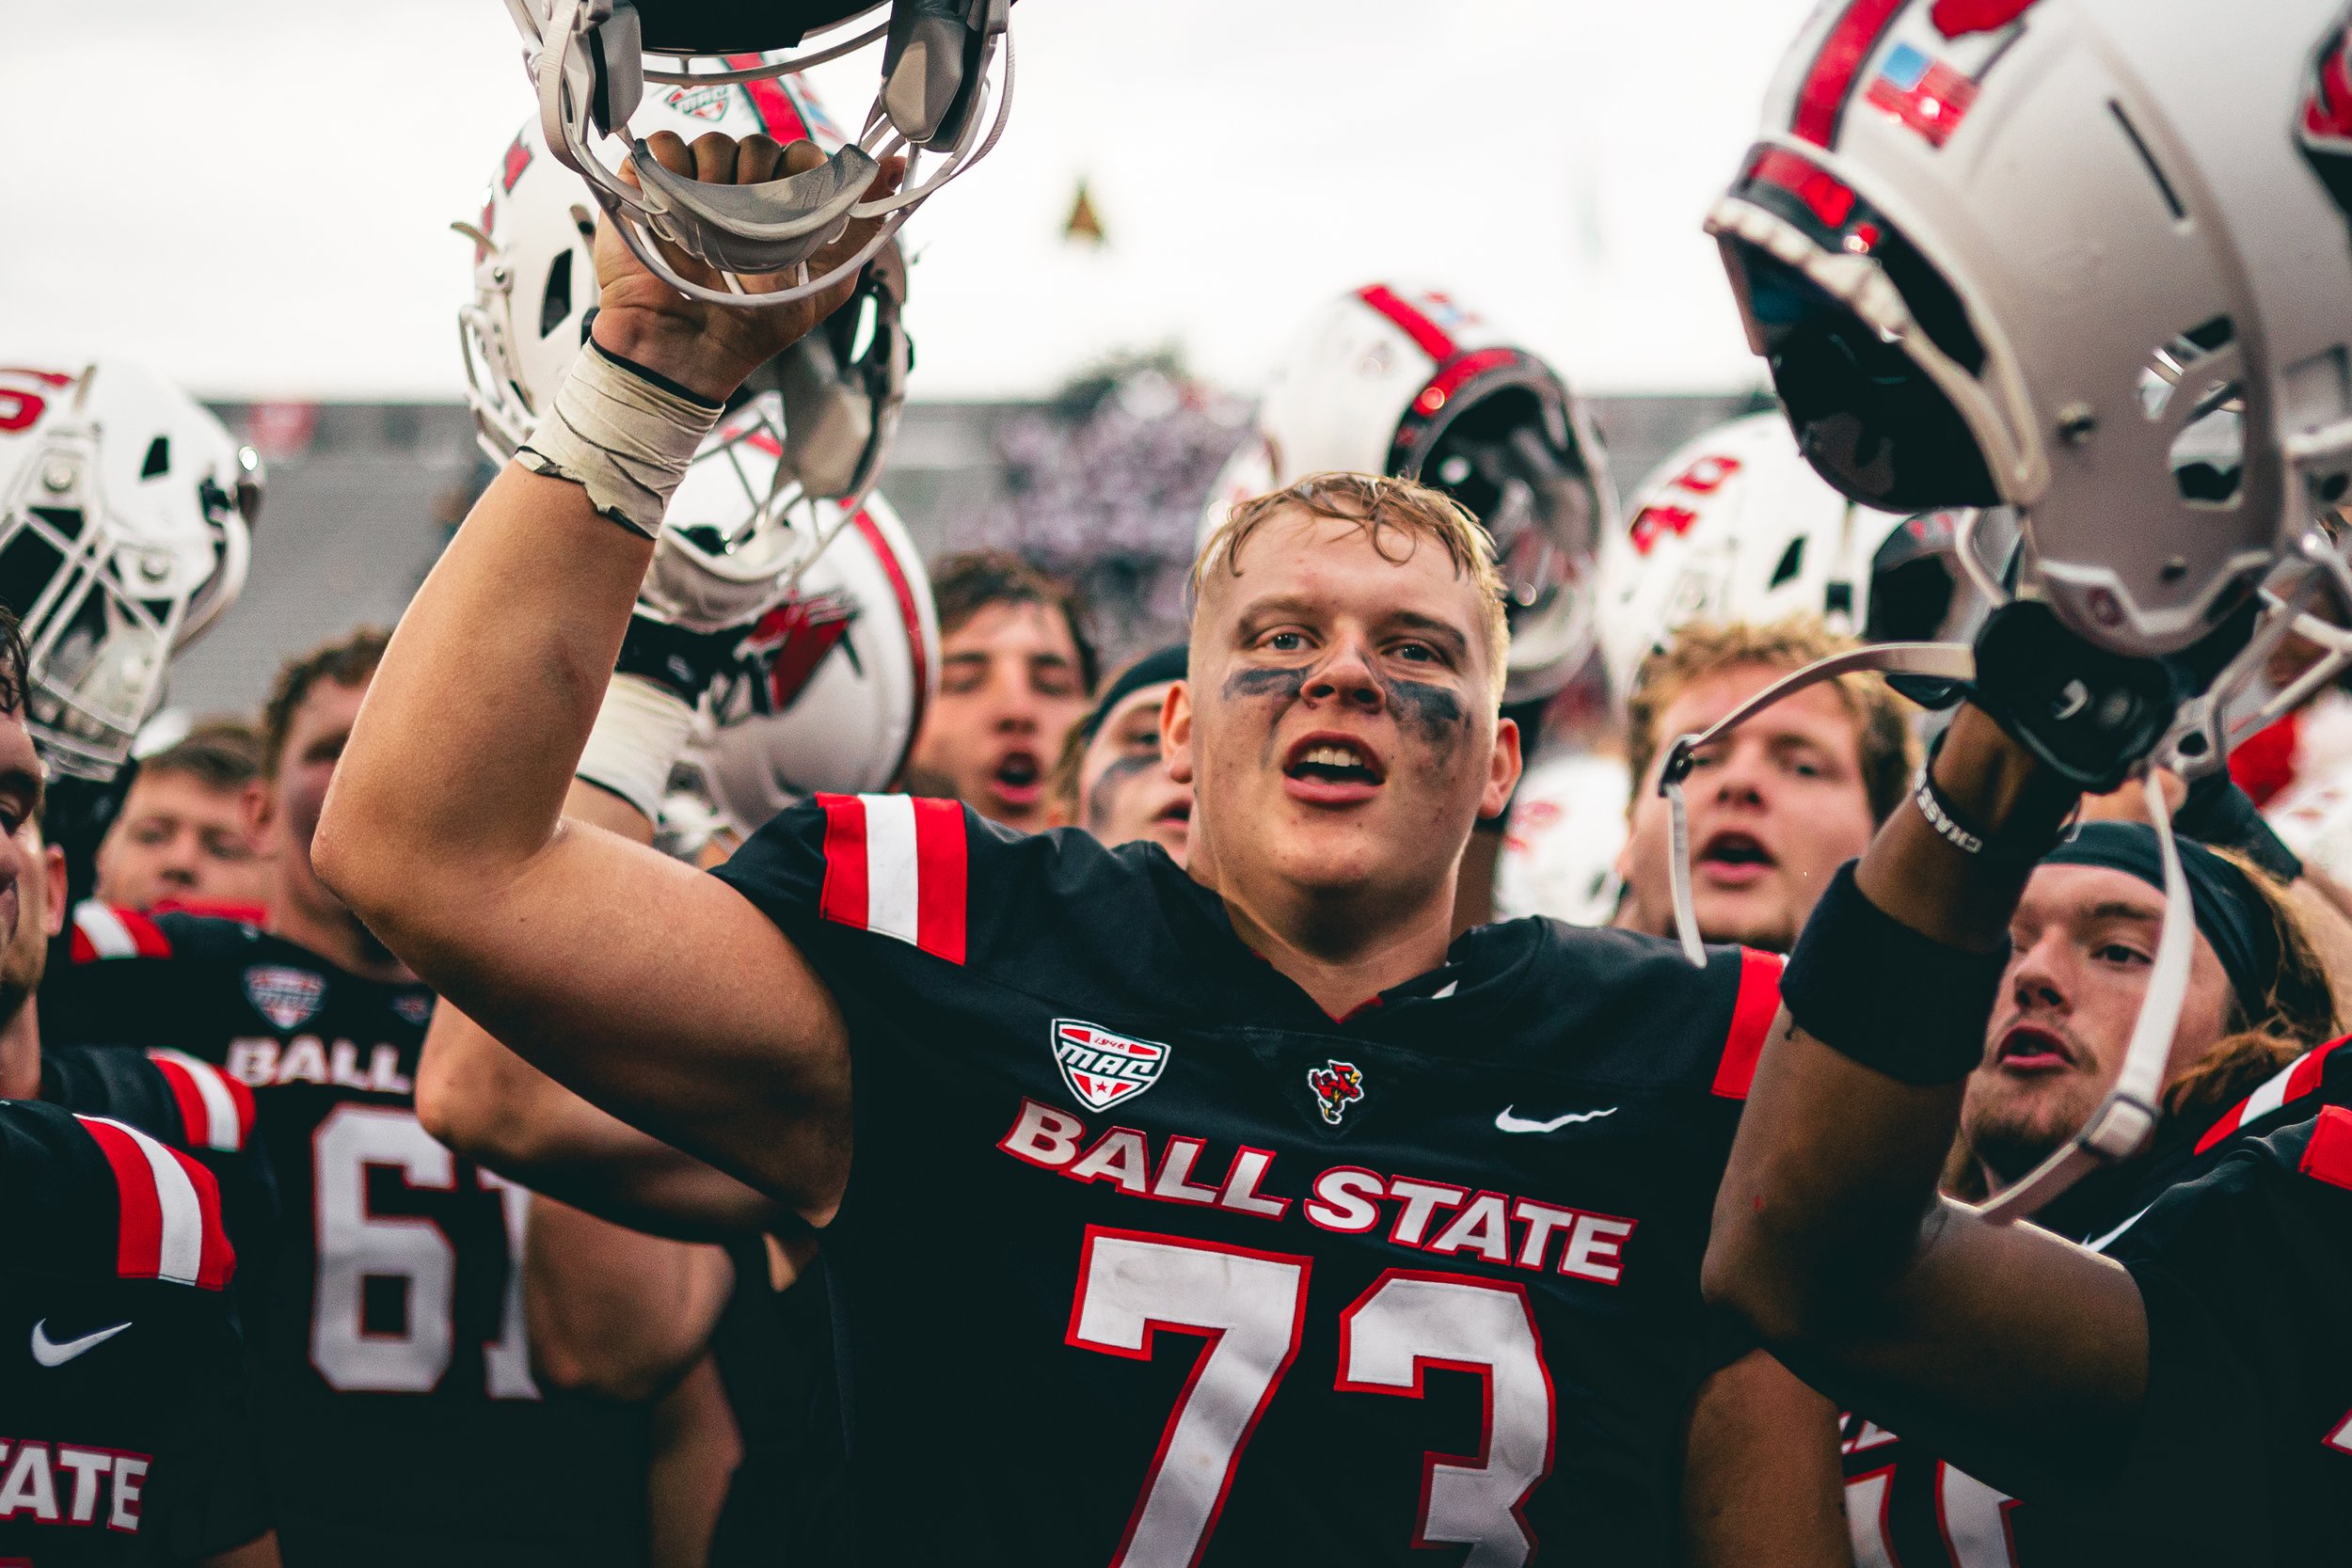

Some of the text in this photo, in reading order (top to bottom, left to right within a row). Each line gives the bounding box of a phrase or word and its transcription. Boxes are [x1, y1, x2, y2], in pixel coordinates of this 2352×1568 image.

[227, 1034, 413, 1094] BALL
[1057, 1041, 1155, 1083] MAC
[1092, 1036, 1127, 1051] 1946
[997, 1098, 1639, 1287] BALL STATE
[1065, 1224, 1557, 1568] 73
